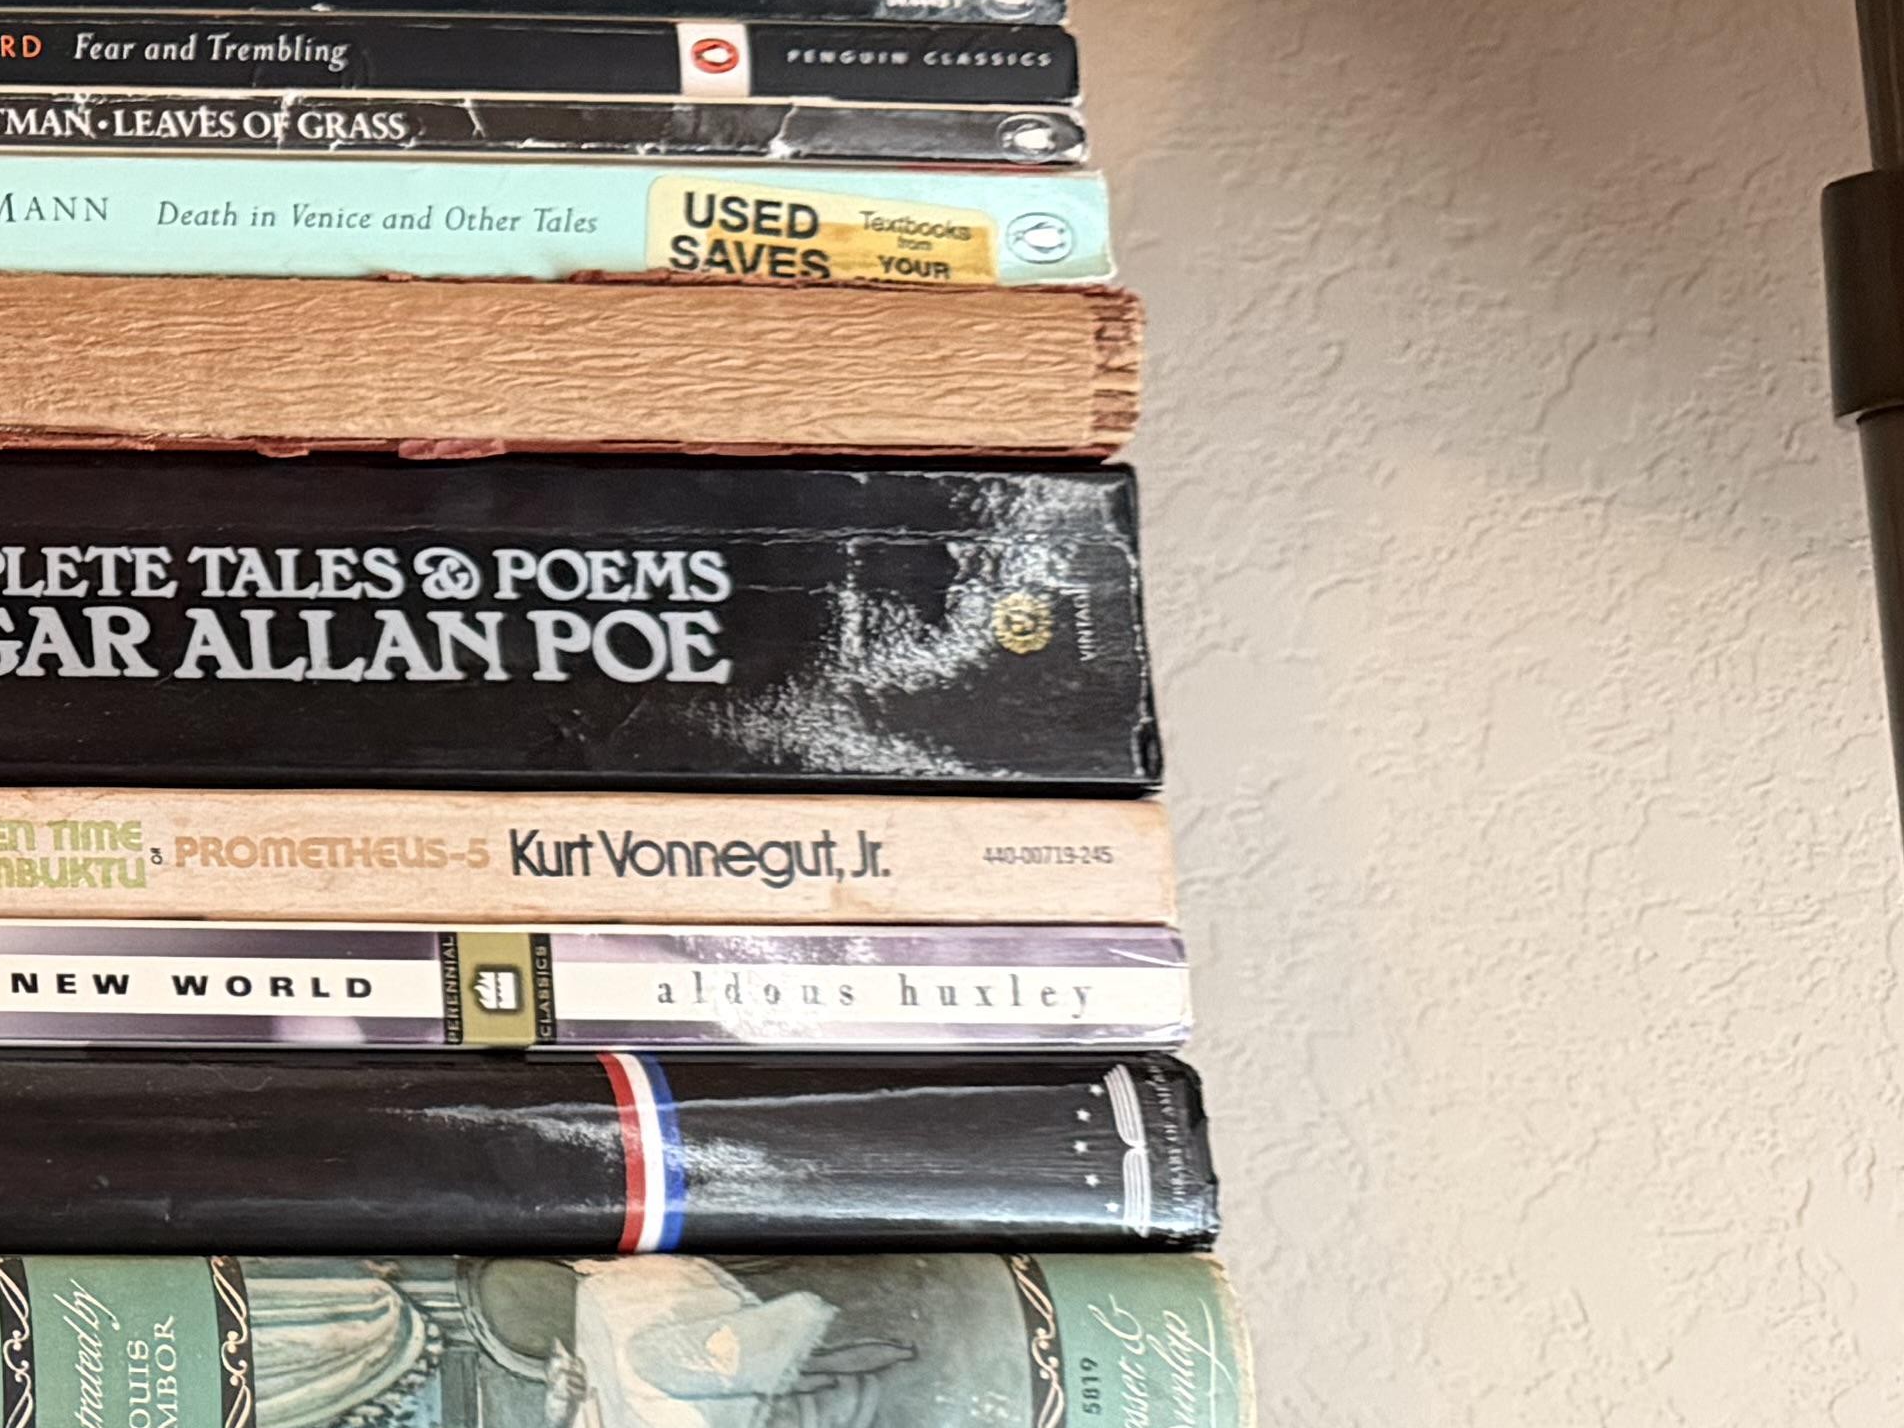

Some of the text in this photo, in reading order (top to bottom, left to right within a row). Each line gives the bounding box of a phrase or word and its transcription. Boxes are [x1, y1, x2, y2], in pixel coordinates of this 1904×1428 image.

[73, 33, 135, 61] Fear
[143, 34, 196, 62] and
[208, 34, 348, 72] Trembling
[787, 48, 908, 66] PENGUIN
[923, 50, 1053, 69] CLASSICS
[157, 200, 238, 228] Death
[251, 203, 277, 228] in
[291, 203, 372, 231] Venice
[382, 206, 433, 231] and
[445, 206, 522, 233] Other
[535, 206, 598, 234] Tales
[684, 191, 820, 241] USED
[858, 210, 972, 243] Textbooks
[877, 254, 952, 279] YOUR
[509, 827, 596, 878] Kurt
[598, 829, 845, 889] Vonnegut,
[850, 829, 892, 878] Jr.
[657, 971, 1096, 1019] aldous huxley
